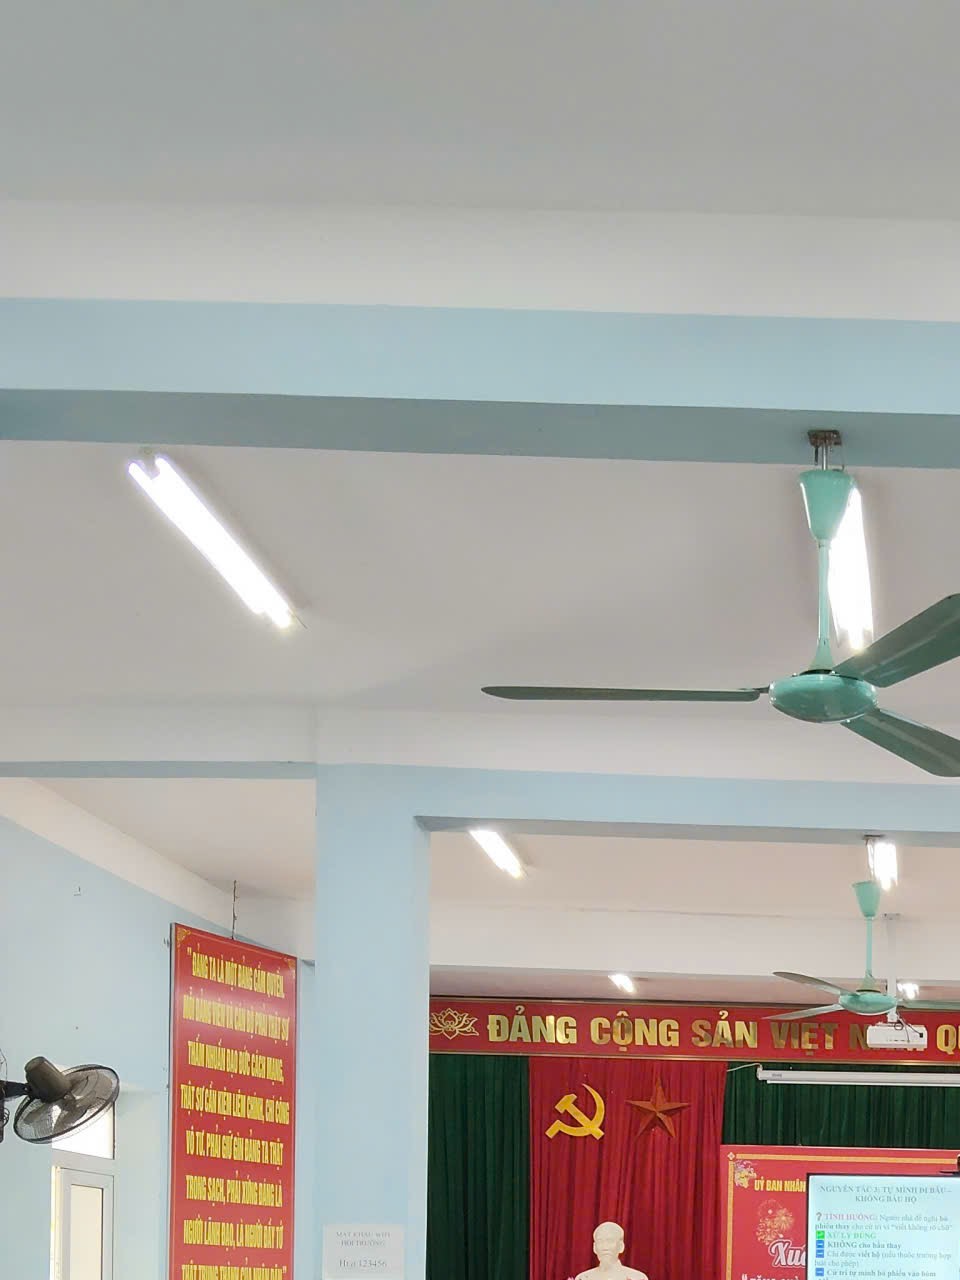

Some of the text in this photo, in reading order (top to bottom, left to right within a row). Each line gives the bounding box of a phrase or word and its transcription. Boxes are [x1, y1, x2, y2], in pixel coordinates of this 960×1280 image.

[488, 1005, 577, 1044] ĐẢNG
[591, 1010, 680, 1052] CỘNG
[692, 1010, 758, 1049] SẢN
